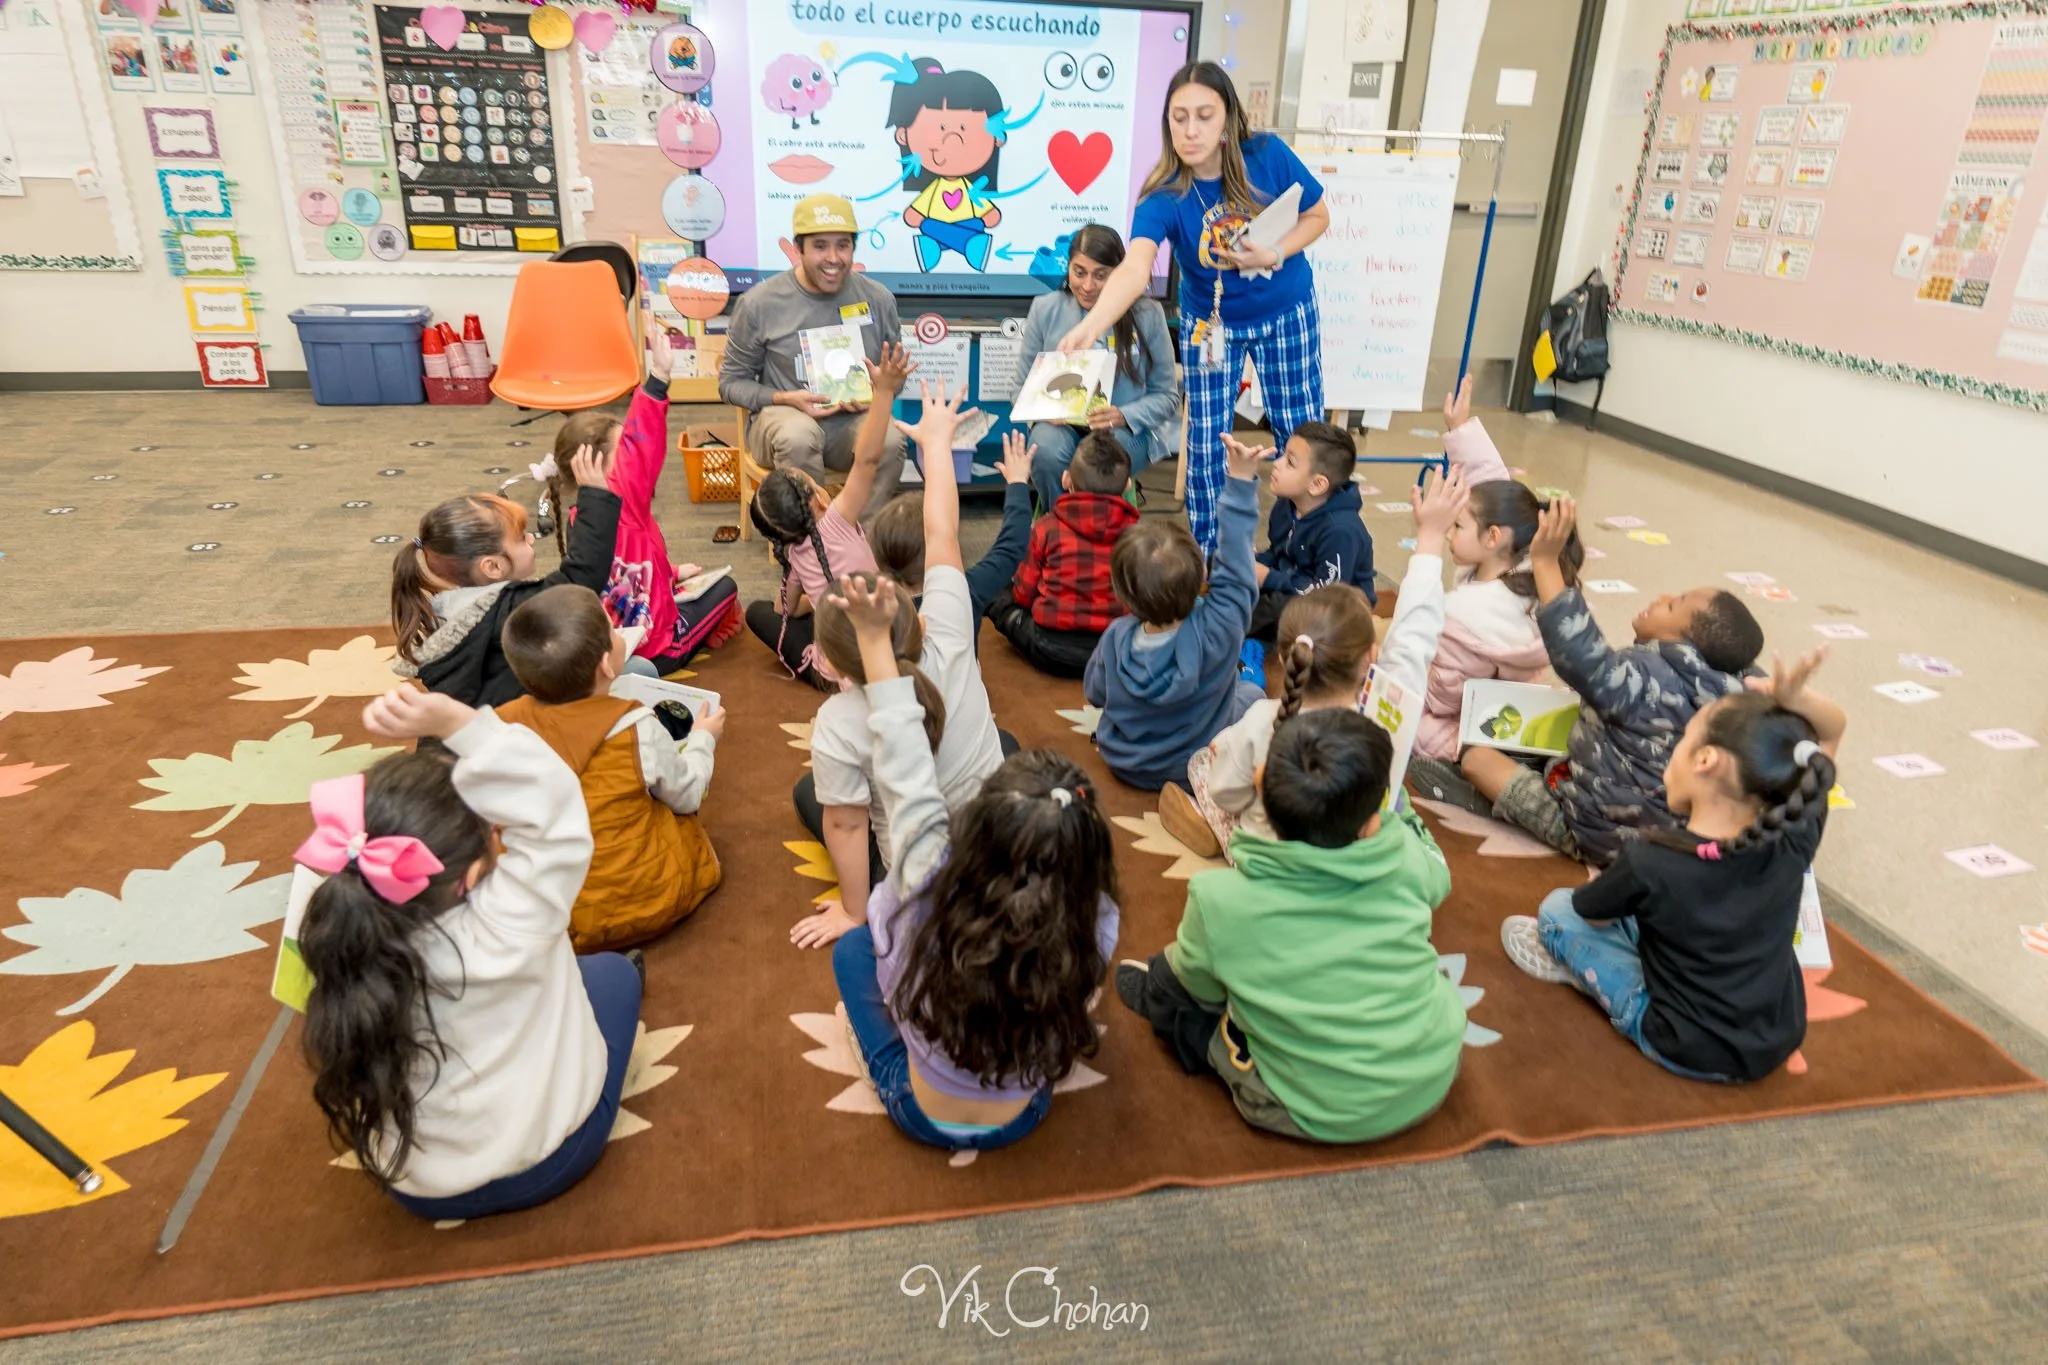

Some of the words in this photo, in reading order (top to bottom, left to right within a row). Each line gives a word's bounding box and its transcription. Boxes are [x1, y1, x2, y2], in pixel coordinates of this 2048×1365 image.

[791, 0, 846, 22] todo
[855, 2, 875, 24] el
[885, 9, 962, 33] cuerpo
[971, 10, 1101, 37] escuchando
[1353, 72, 1380, 87] EXIT
